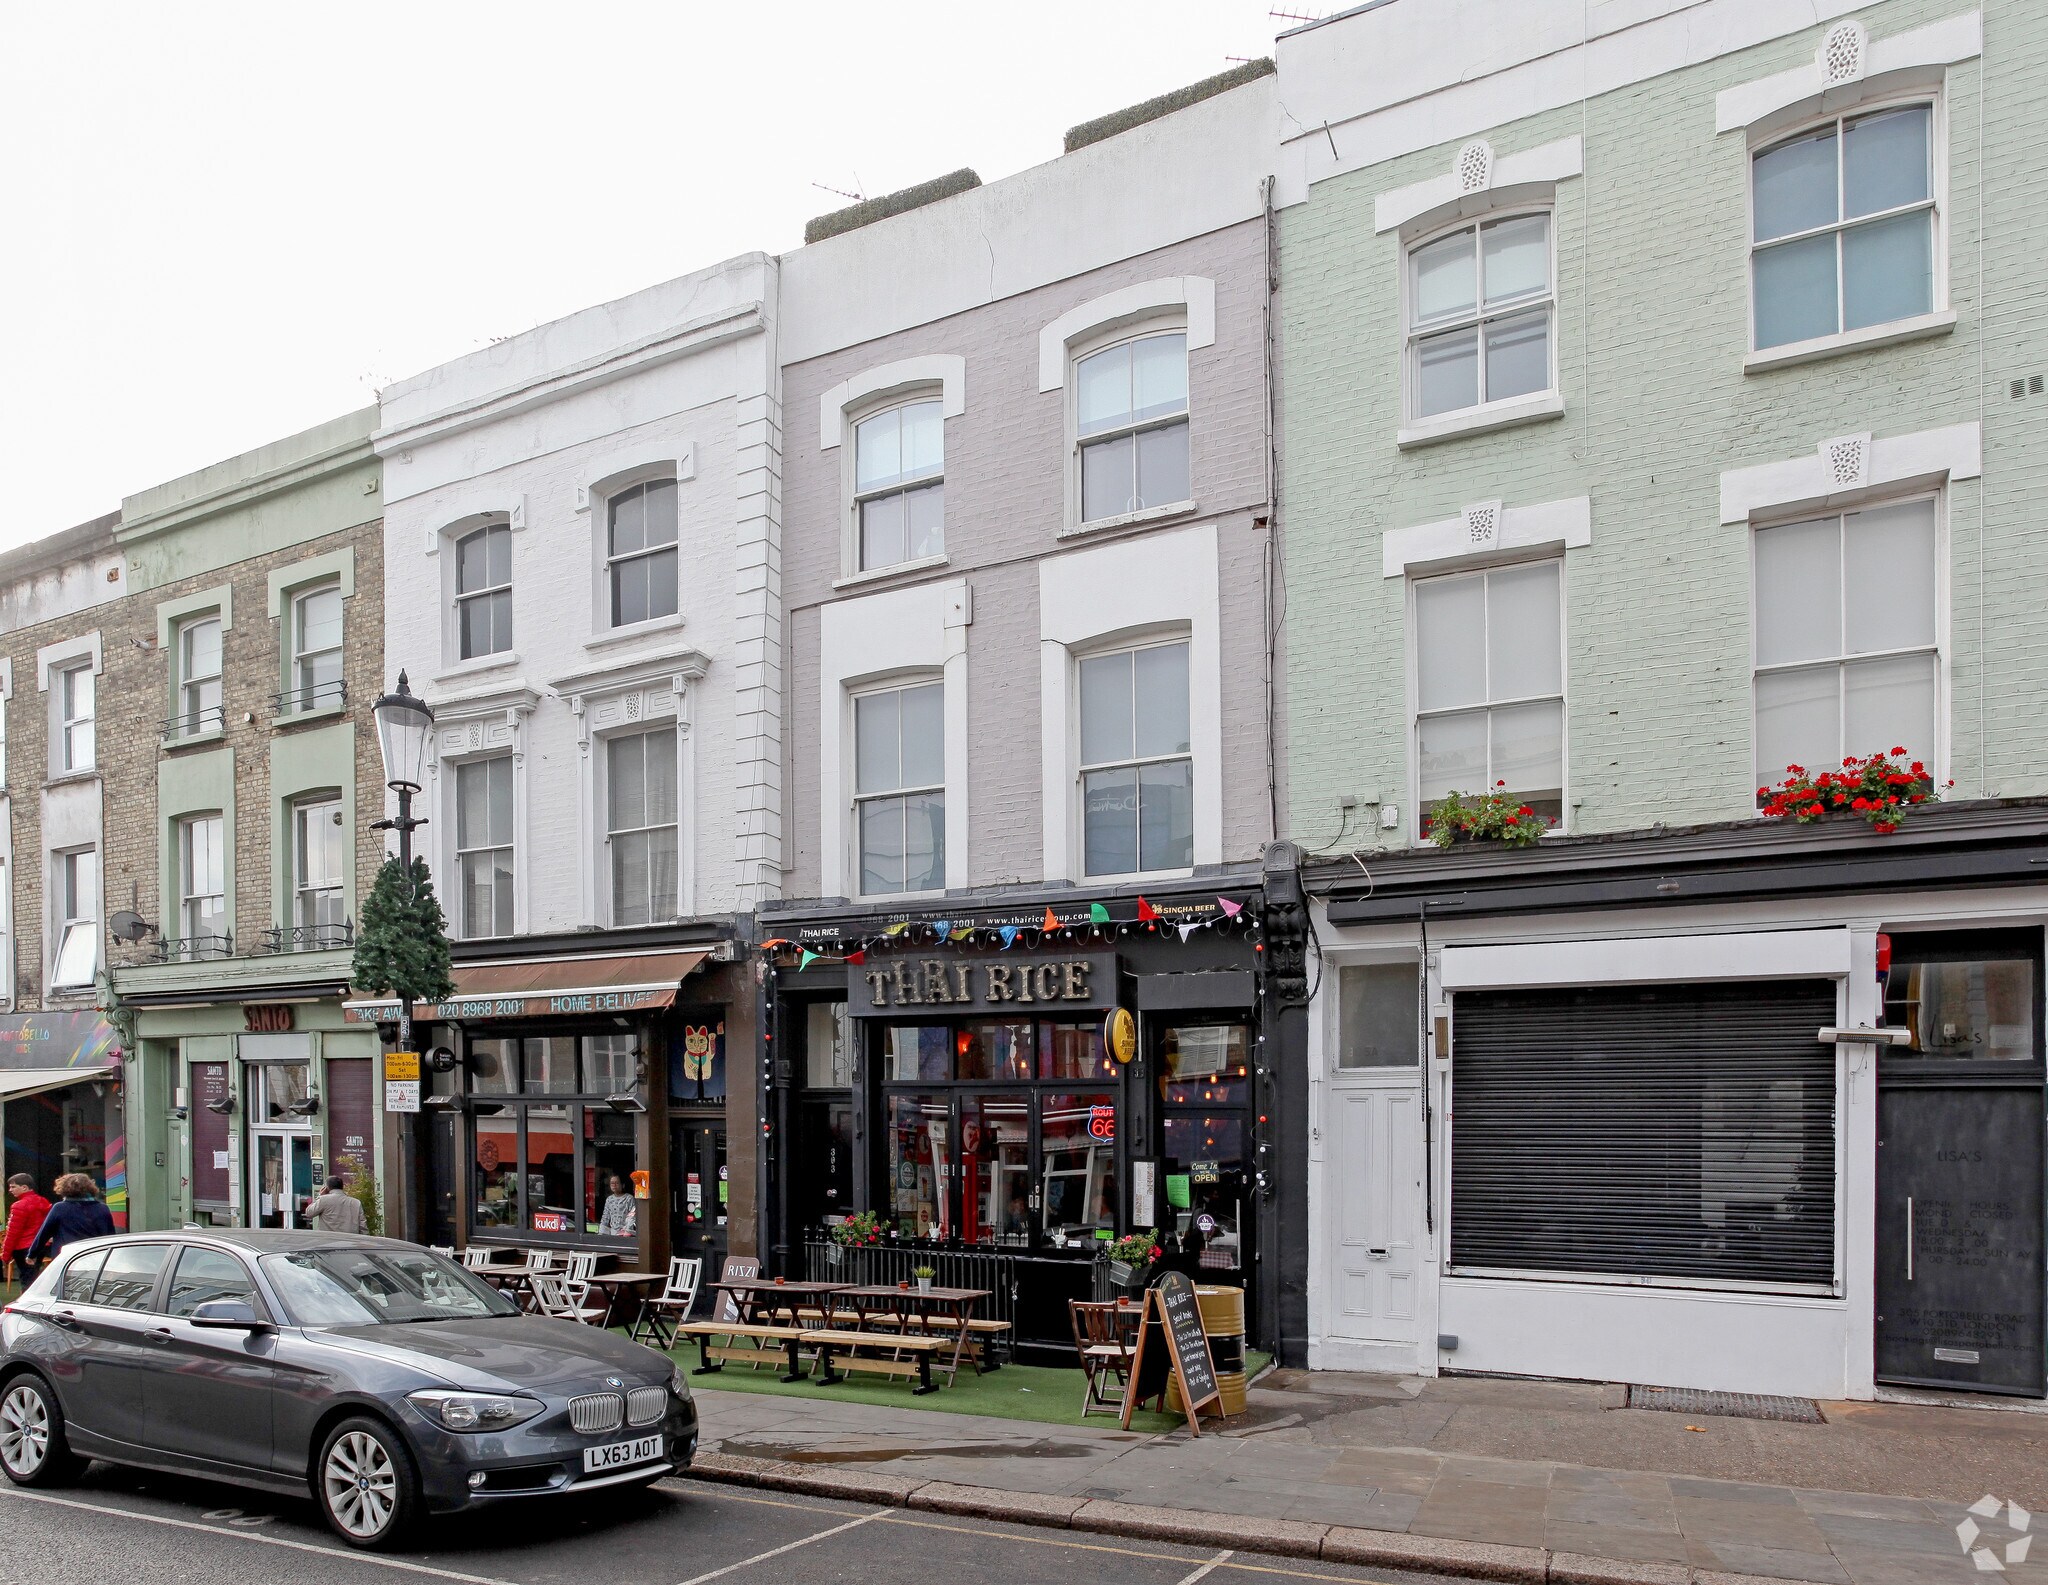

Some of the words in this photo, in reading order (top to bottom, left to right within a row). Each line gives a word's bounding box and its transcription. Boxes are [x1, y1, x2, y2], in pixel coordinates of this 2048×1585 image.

[1163, 906, 1193, 914] SINGHA
[1195, 904, 1216, 912] BEER
[953, 919, 975, 928] 2001
[987, 912, 1091, 924] www.thairiceoup.com
[803, 929, 821, 938] THAI
[821, 928, 839, 936] RICE
[865, 959, 973, 1006] THAI
[984, 960, 1092, 1003] RICE
[437, 1004, 459, 1018] 020
[462, 1002, 492, 1017] 8968
[495, 1000, 525, 1015] 2001
[550, 996, 592, 1012] HOME
[243, 1006, 293, 1031] SANTO
[383, 1006, 402, 1021] AW
[207, 1066, 223, 1076] SANTO
[1092, 1108, 1114, 1117] ROUT
[1092, 1118, 1115, 1137] 66
[345, 1135, 364, 1147] SANTO
[1937, 1150, 1982, 1162] LISA'S
[1191, 1163, 1208, 1171] Come
[1209, 1162, 1218, 1170] In
[1194, 1174, 1217, 1182] OPEN
[1969, 1201, 2010, 1211] HOURS
[1969, 1210, 2013, 1220] CLOSED
[1920, 1246, 1970, 1256] HURSDAY
[1984, 1248, 2031, 1259] SUNAY
[1923, 1309, 1990, 1322] PORTOBELLO
[1994, 1313, 2026, 1323] ROAD
[1909, 1318, 1934, 1327] W10
[1963, 1320, 2016, 1332] LONDON
[591, 1444, 630, 1468] LX63
[634, 1438, 657, 1459] AOT
